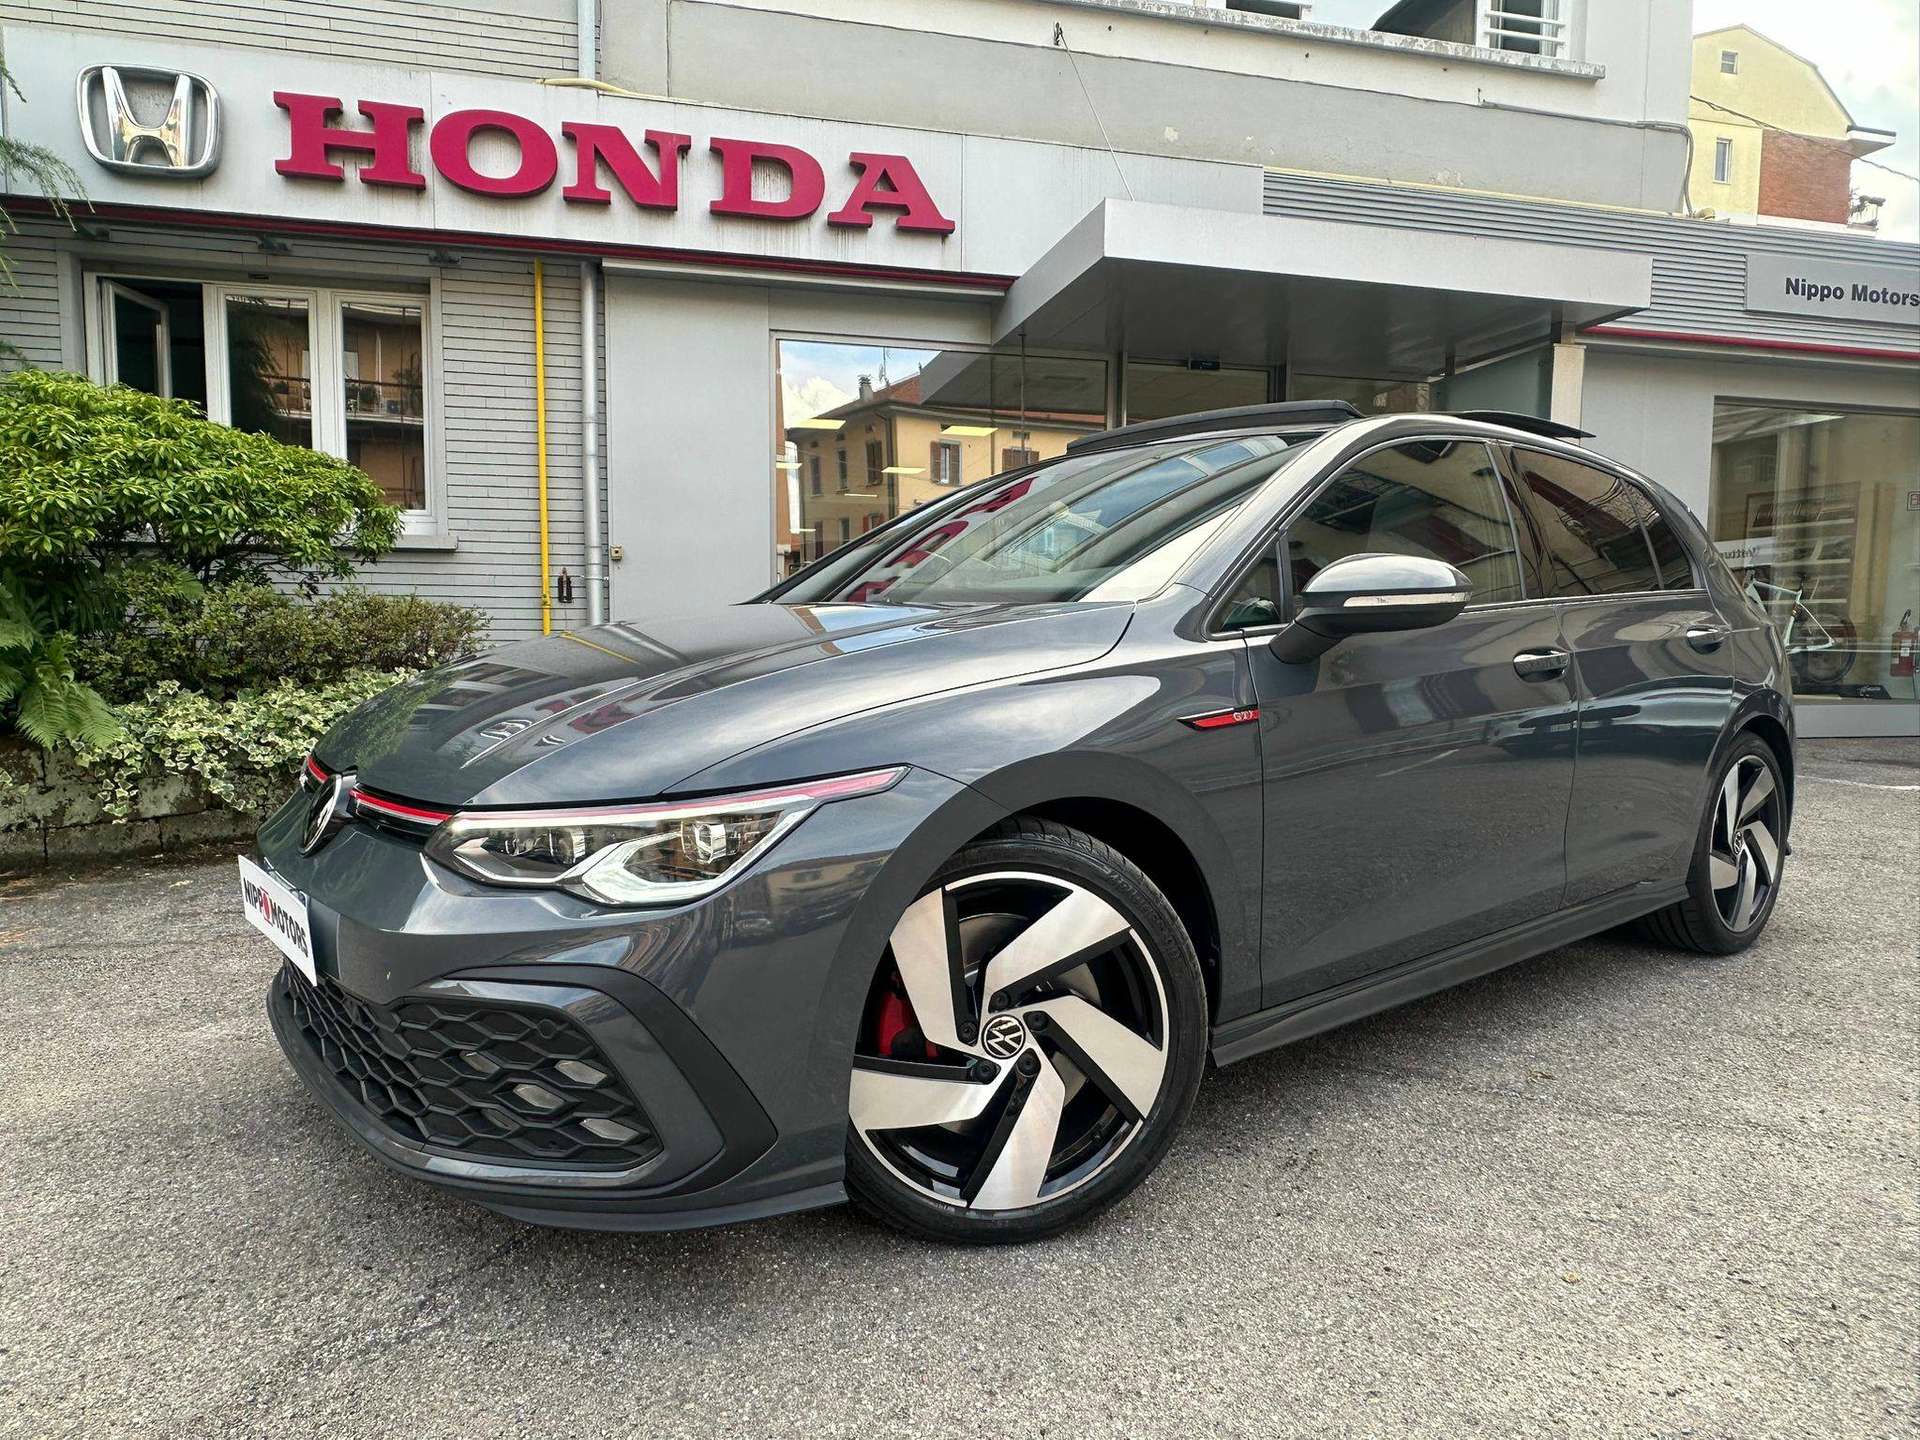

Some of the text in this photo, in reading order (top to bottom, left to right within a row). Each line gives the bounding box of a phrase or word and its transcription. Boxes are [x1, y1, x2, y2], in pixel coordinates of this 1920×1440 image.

[273, 91, 955, 236] HONDA
[1785, 277, 1920, 307] Nippo Motors
[1233, 709, 1253, 721] GTI
[269, 898, 308, 957] MOTORS
